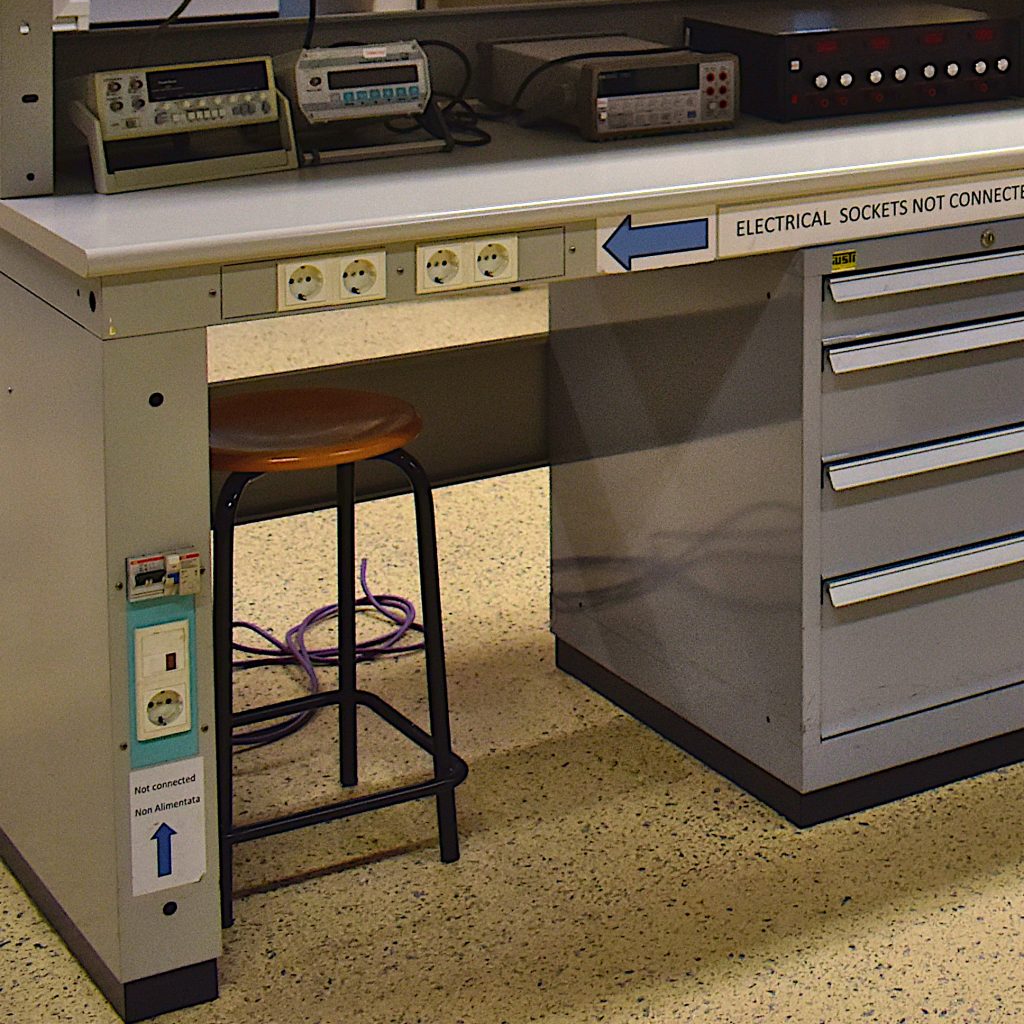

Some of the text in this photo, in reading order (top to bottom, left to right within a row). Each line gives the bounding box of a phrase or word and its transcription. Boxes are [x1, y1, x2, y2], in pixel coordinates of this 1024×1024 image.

[736, 210, 831, 237] ELECTRICAL
[839, 199, 908, 224] SOCKETS
[912, 194, 945, 214] NOT
[134, 774, 196, 795] Not connected
[135, 796, 201, 817] Non Alimentata
